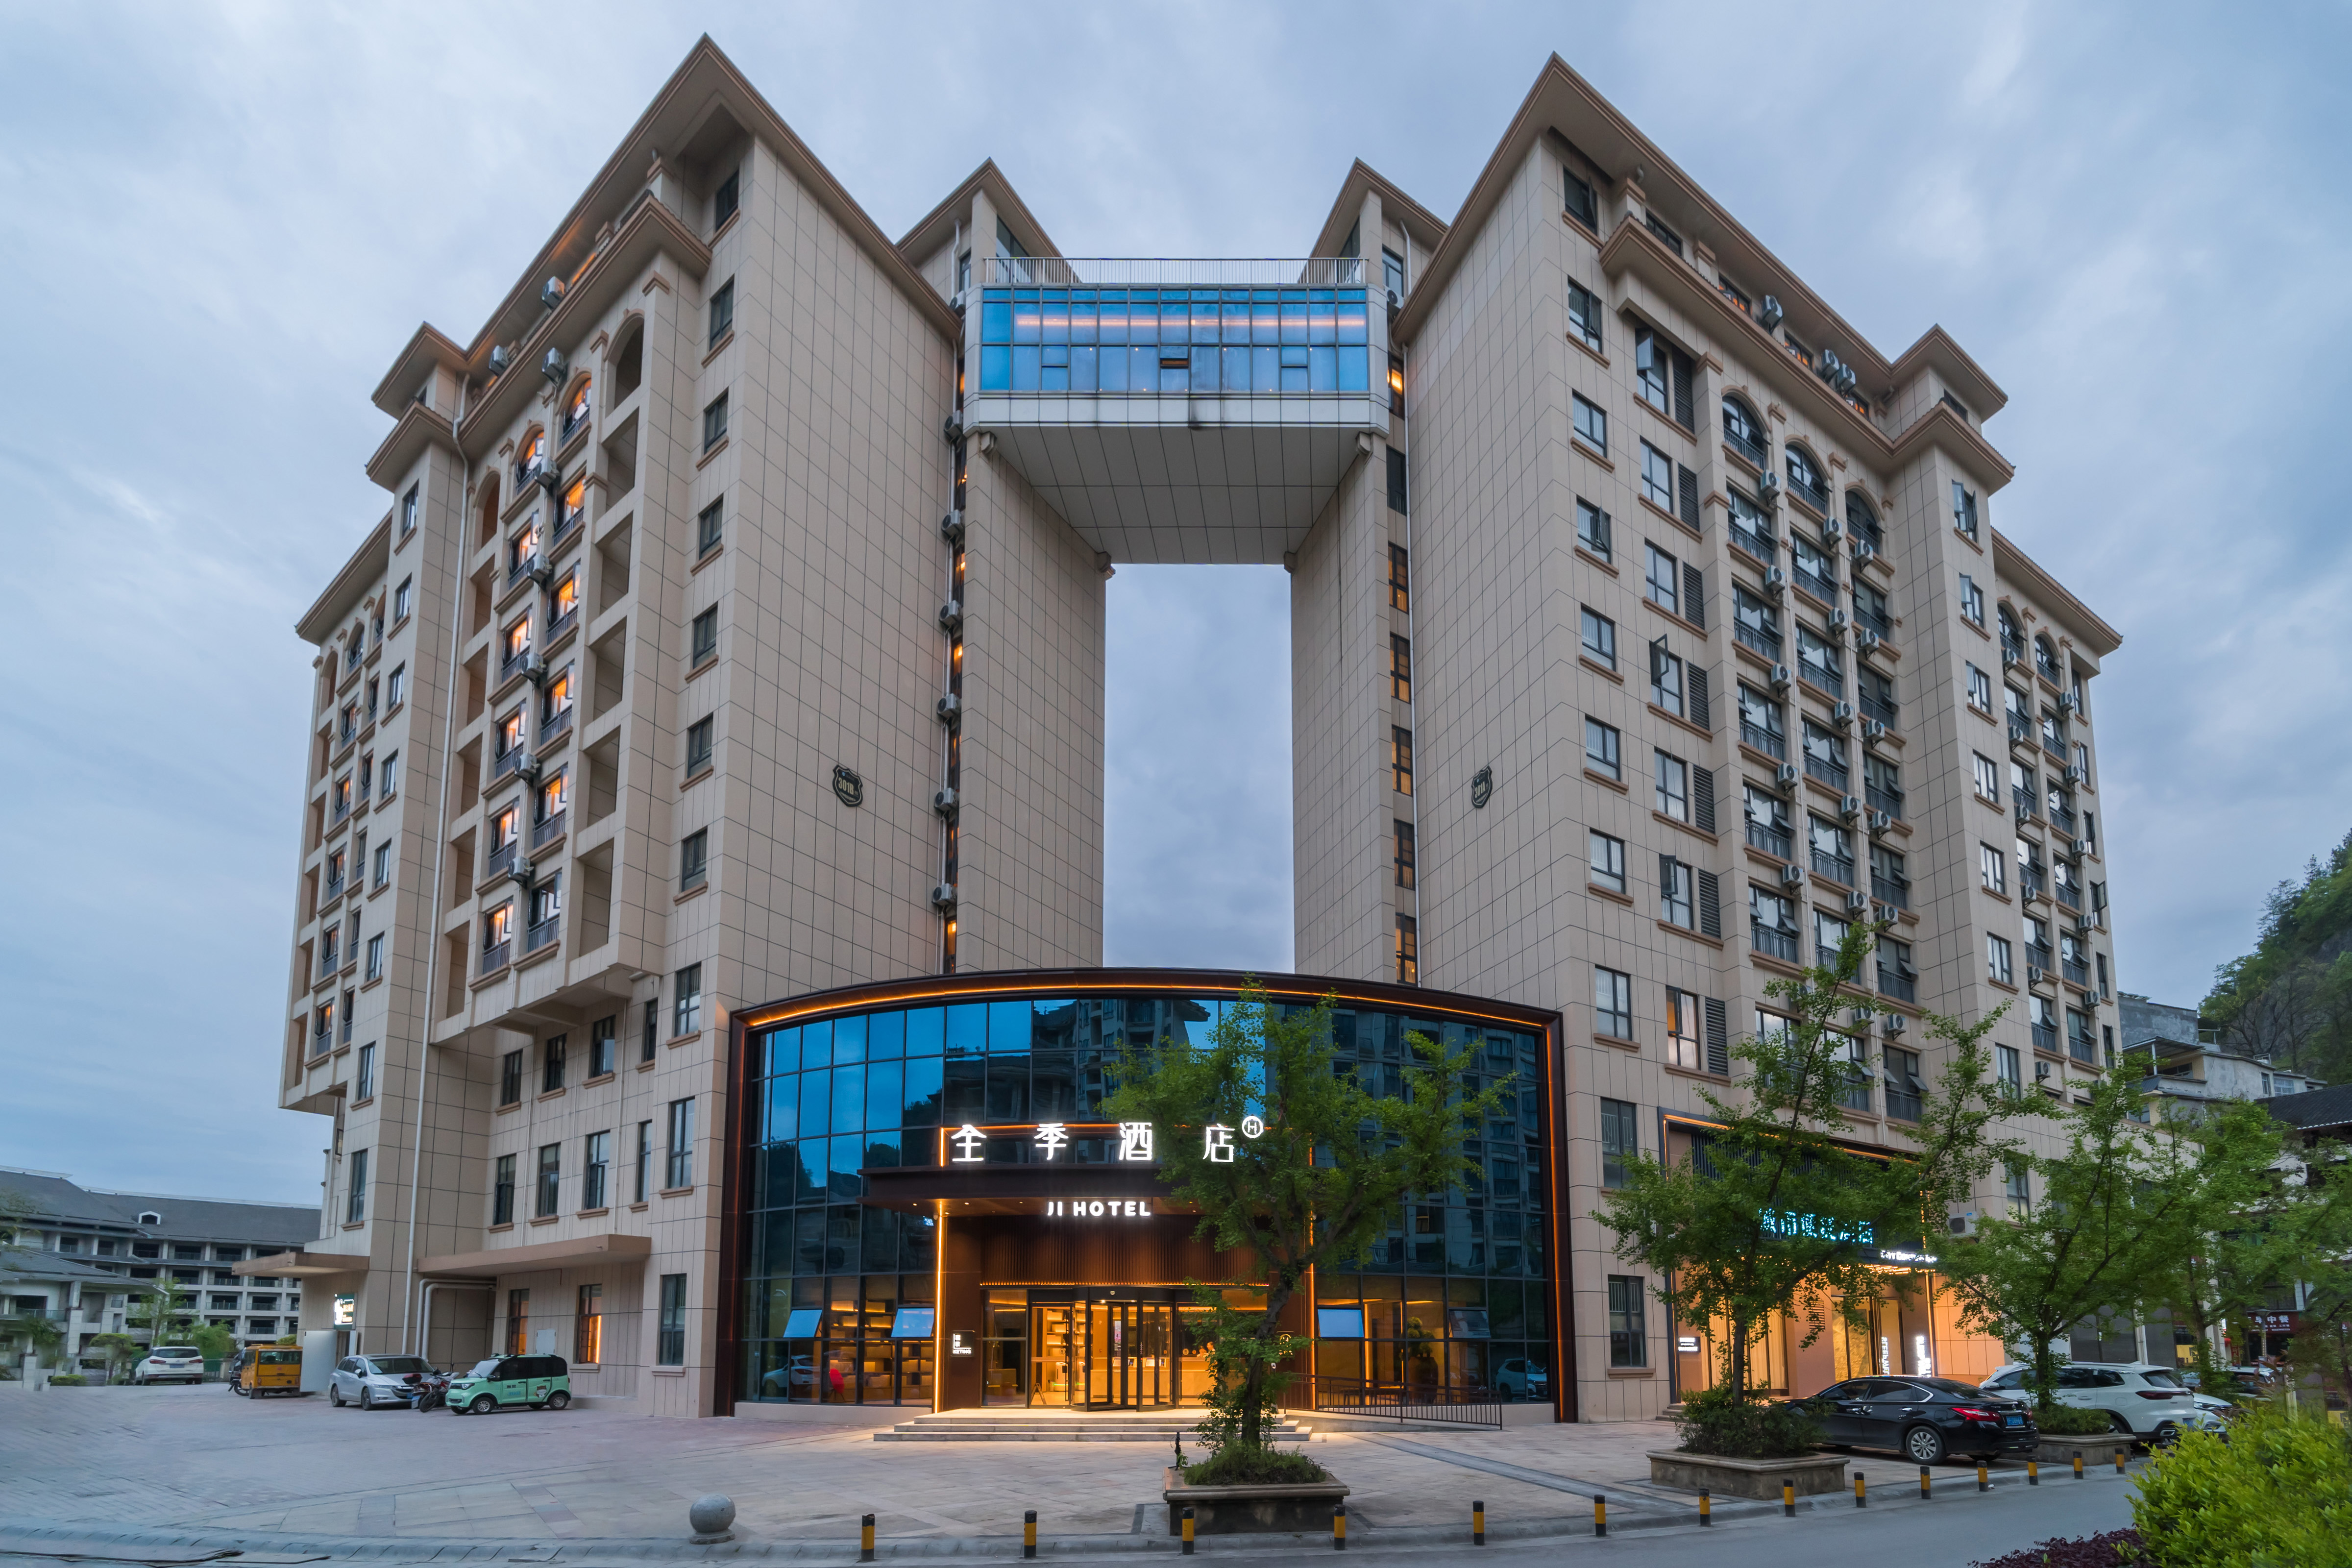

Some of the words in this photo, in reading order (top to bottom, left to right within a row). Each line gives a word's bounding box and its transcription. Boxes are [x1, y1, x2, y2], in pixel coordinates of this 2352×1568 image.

[838, 777, 854, 795] 301B
[1474, 781, 1486, 799] 301A
[951, 1122, 1235, 1163] 全季酒店
[1047, 1201, 1063, 1217] JI
[1073, 1200, 1151, 1217] HOTEL
